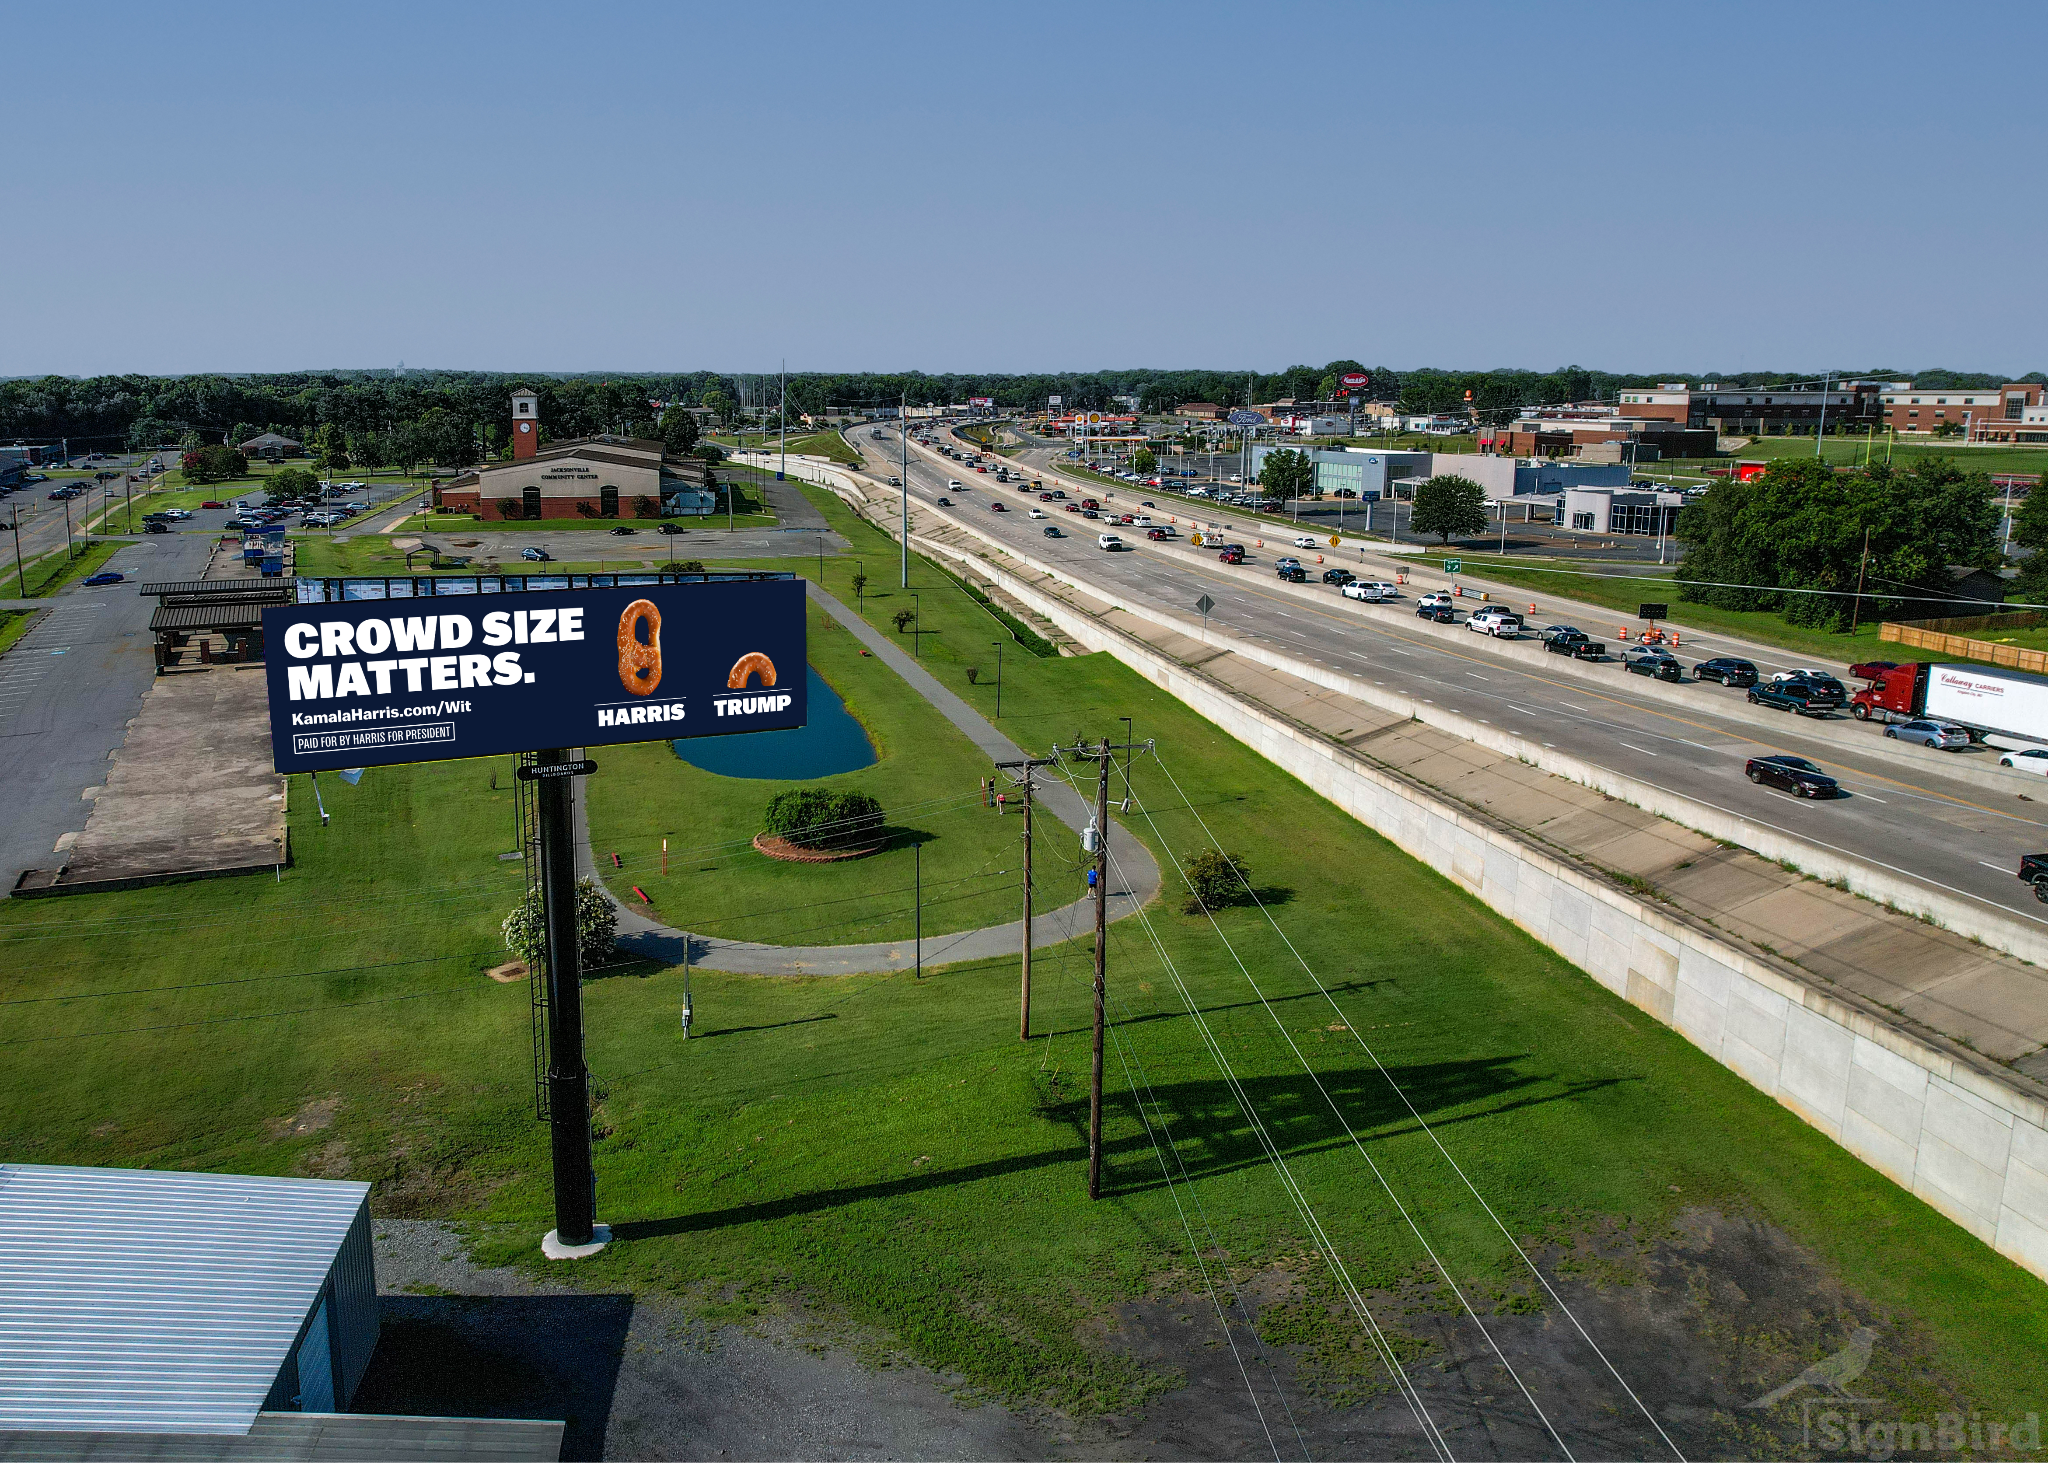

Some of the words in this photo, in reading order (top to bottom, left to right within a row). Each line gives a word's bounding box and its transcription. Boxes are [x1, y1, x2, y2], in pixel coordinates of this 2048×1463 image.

[1236, 413, 1258, 424] Ford
[284, 614, 473, 659] CROWD
[481, 607, 585, 647] SIZE
[287, 651, 536, 701] MATTERS.
[1940, 673, 1973, 690] Callaway
[1975, 683, 2004, 693] CARRIERS
[291, 700, 472, 726] KamalaHarris.com/Wit
[597, 703, 686, 727] HARRIS
[713, 695, 792, 717] TRUMP
[298, 737, 319, 750] PAID
[320, 735, 338, 748] FOR
[339, 734, 351, 746] BY
[352, 731, 386, 745] HARRIS
[387, 729, 404, 742] FOR
[405, 726, 451, 741] PRESIDENT
[531, 763, 584, 774] HUNTINGTON
